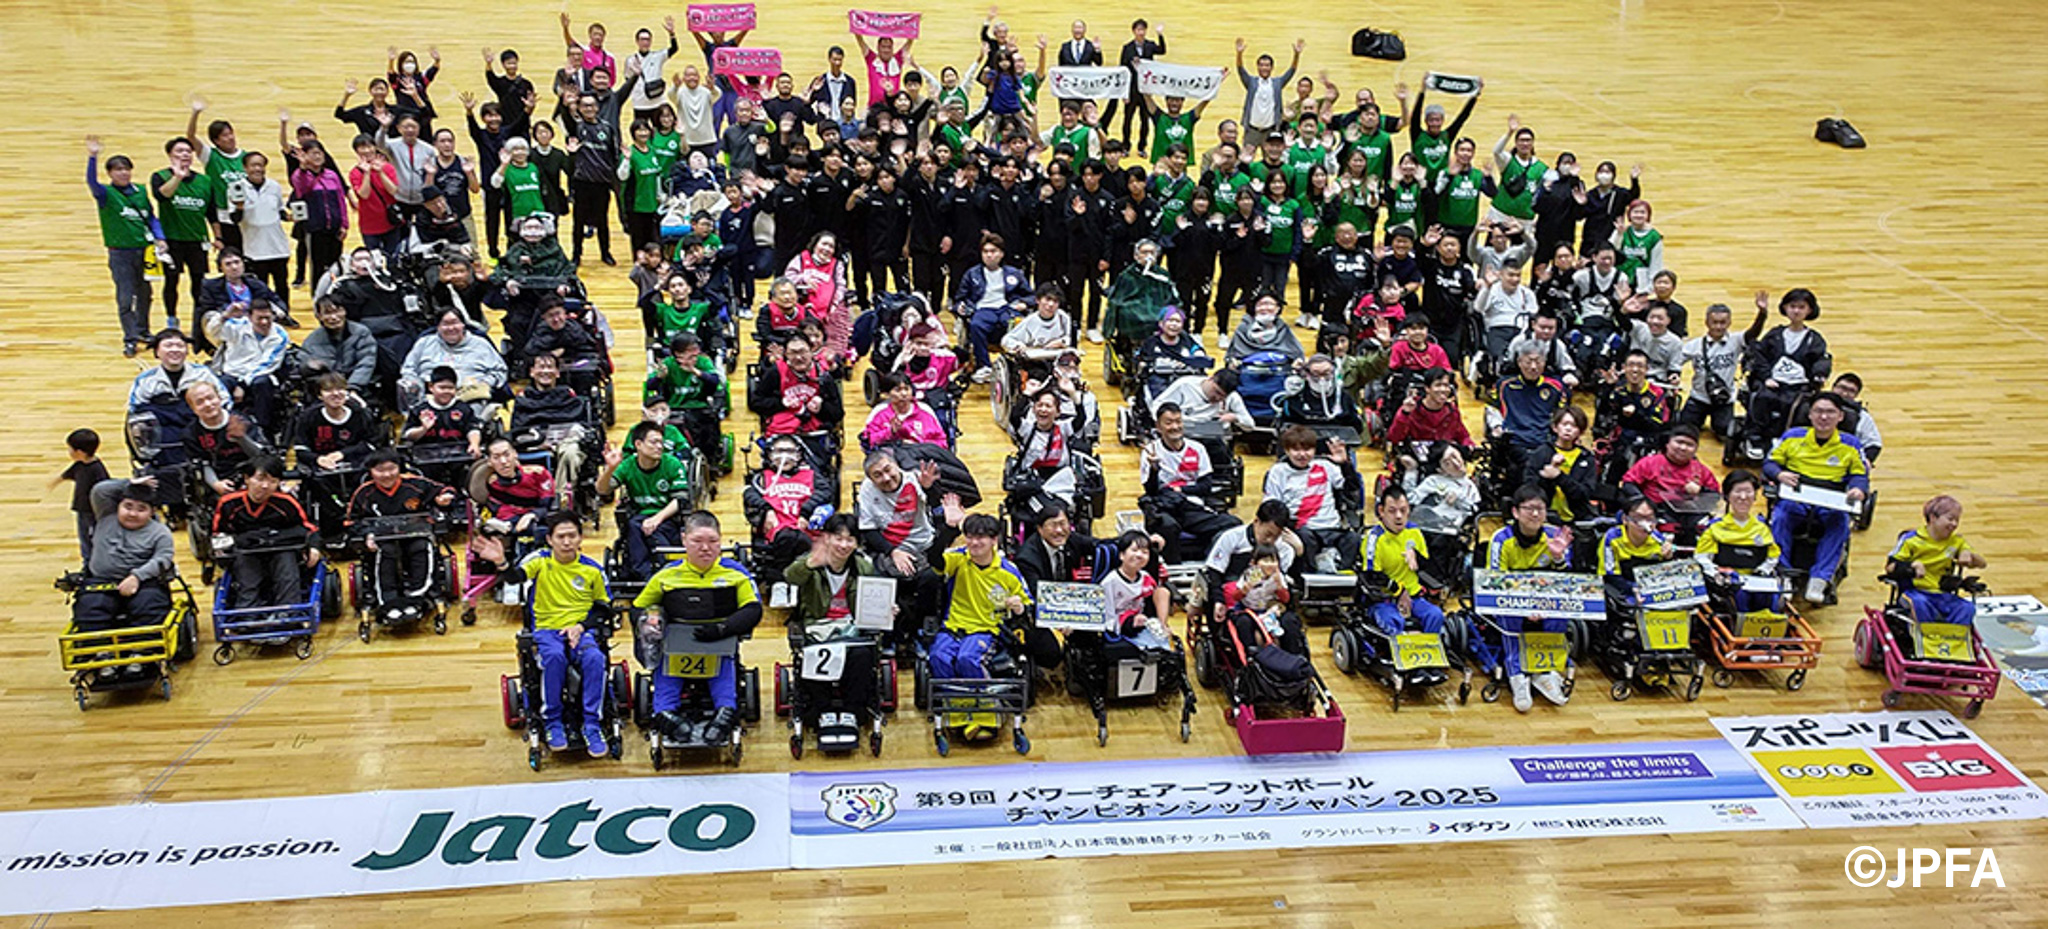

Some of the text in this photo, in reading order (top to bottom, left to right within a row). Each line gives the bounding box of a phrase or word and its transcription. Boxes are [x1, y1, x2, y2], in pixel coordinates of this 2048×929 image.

[781, 499, 799, 515] 17
[1496, 596, 1585, 612] CHAMPION 2025
[1662, 628, 1678, 645] 11
[1760, 625, 1772, 638] 9
[680, 655, 707, 674] 24
[815, 647, 831, 676] 2
[1409, 651, 1433, 665] 22
[1534, 651, 1556, 669] 21
[1131, 666, 1145, 692] 7
[1730, 717, 1970, 748] スポーツくじ
[1523, 756, 1691, 773] Challenge the limits
[1778, 763, 1874, 779] toto
[915, 776, 1375, 808] 第9回 パワーチェアーフットボール
[1005, 786, 1500, 823] チャンピオンシップジャパン 2025
[351, 798, 757, 871] Jatco
[1443, 819, 1511, 834] イチケン
[6, 837, 341, 872] mission is passion.
